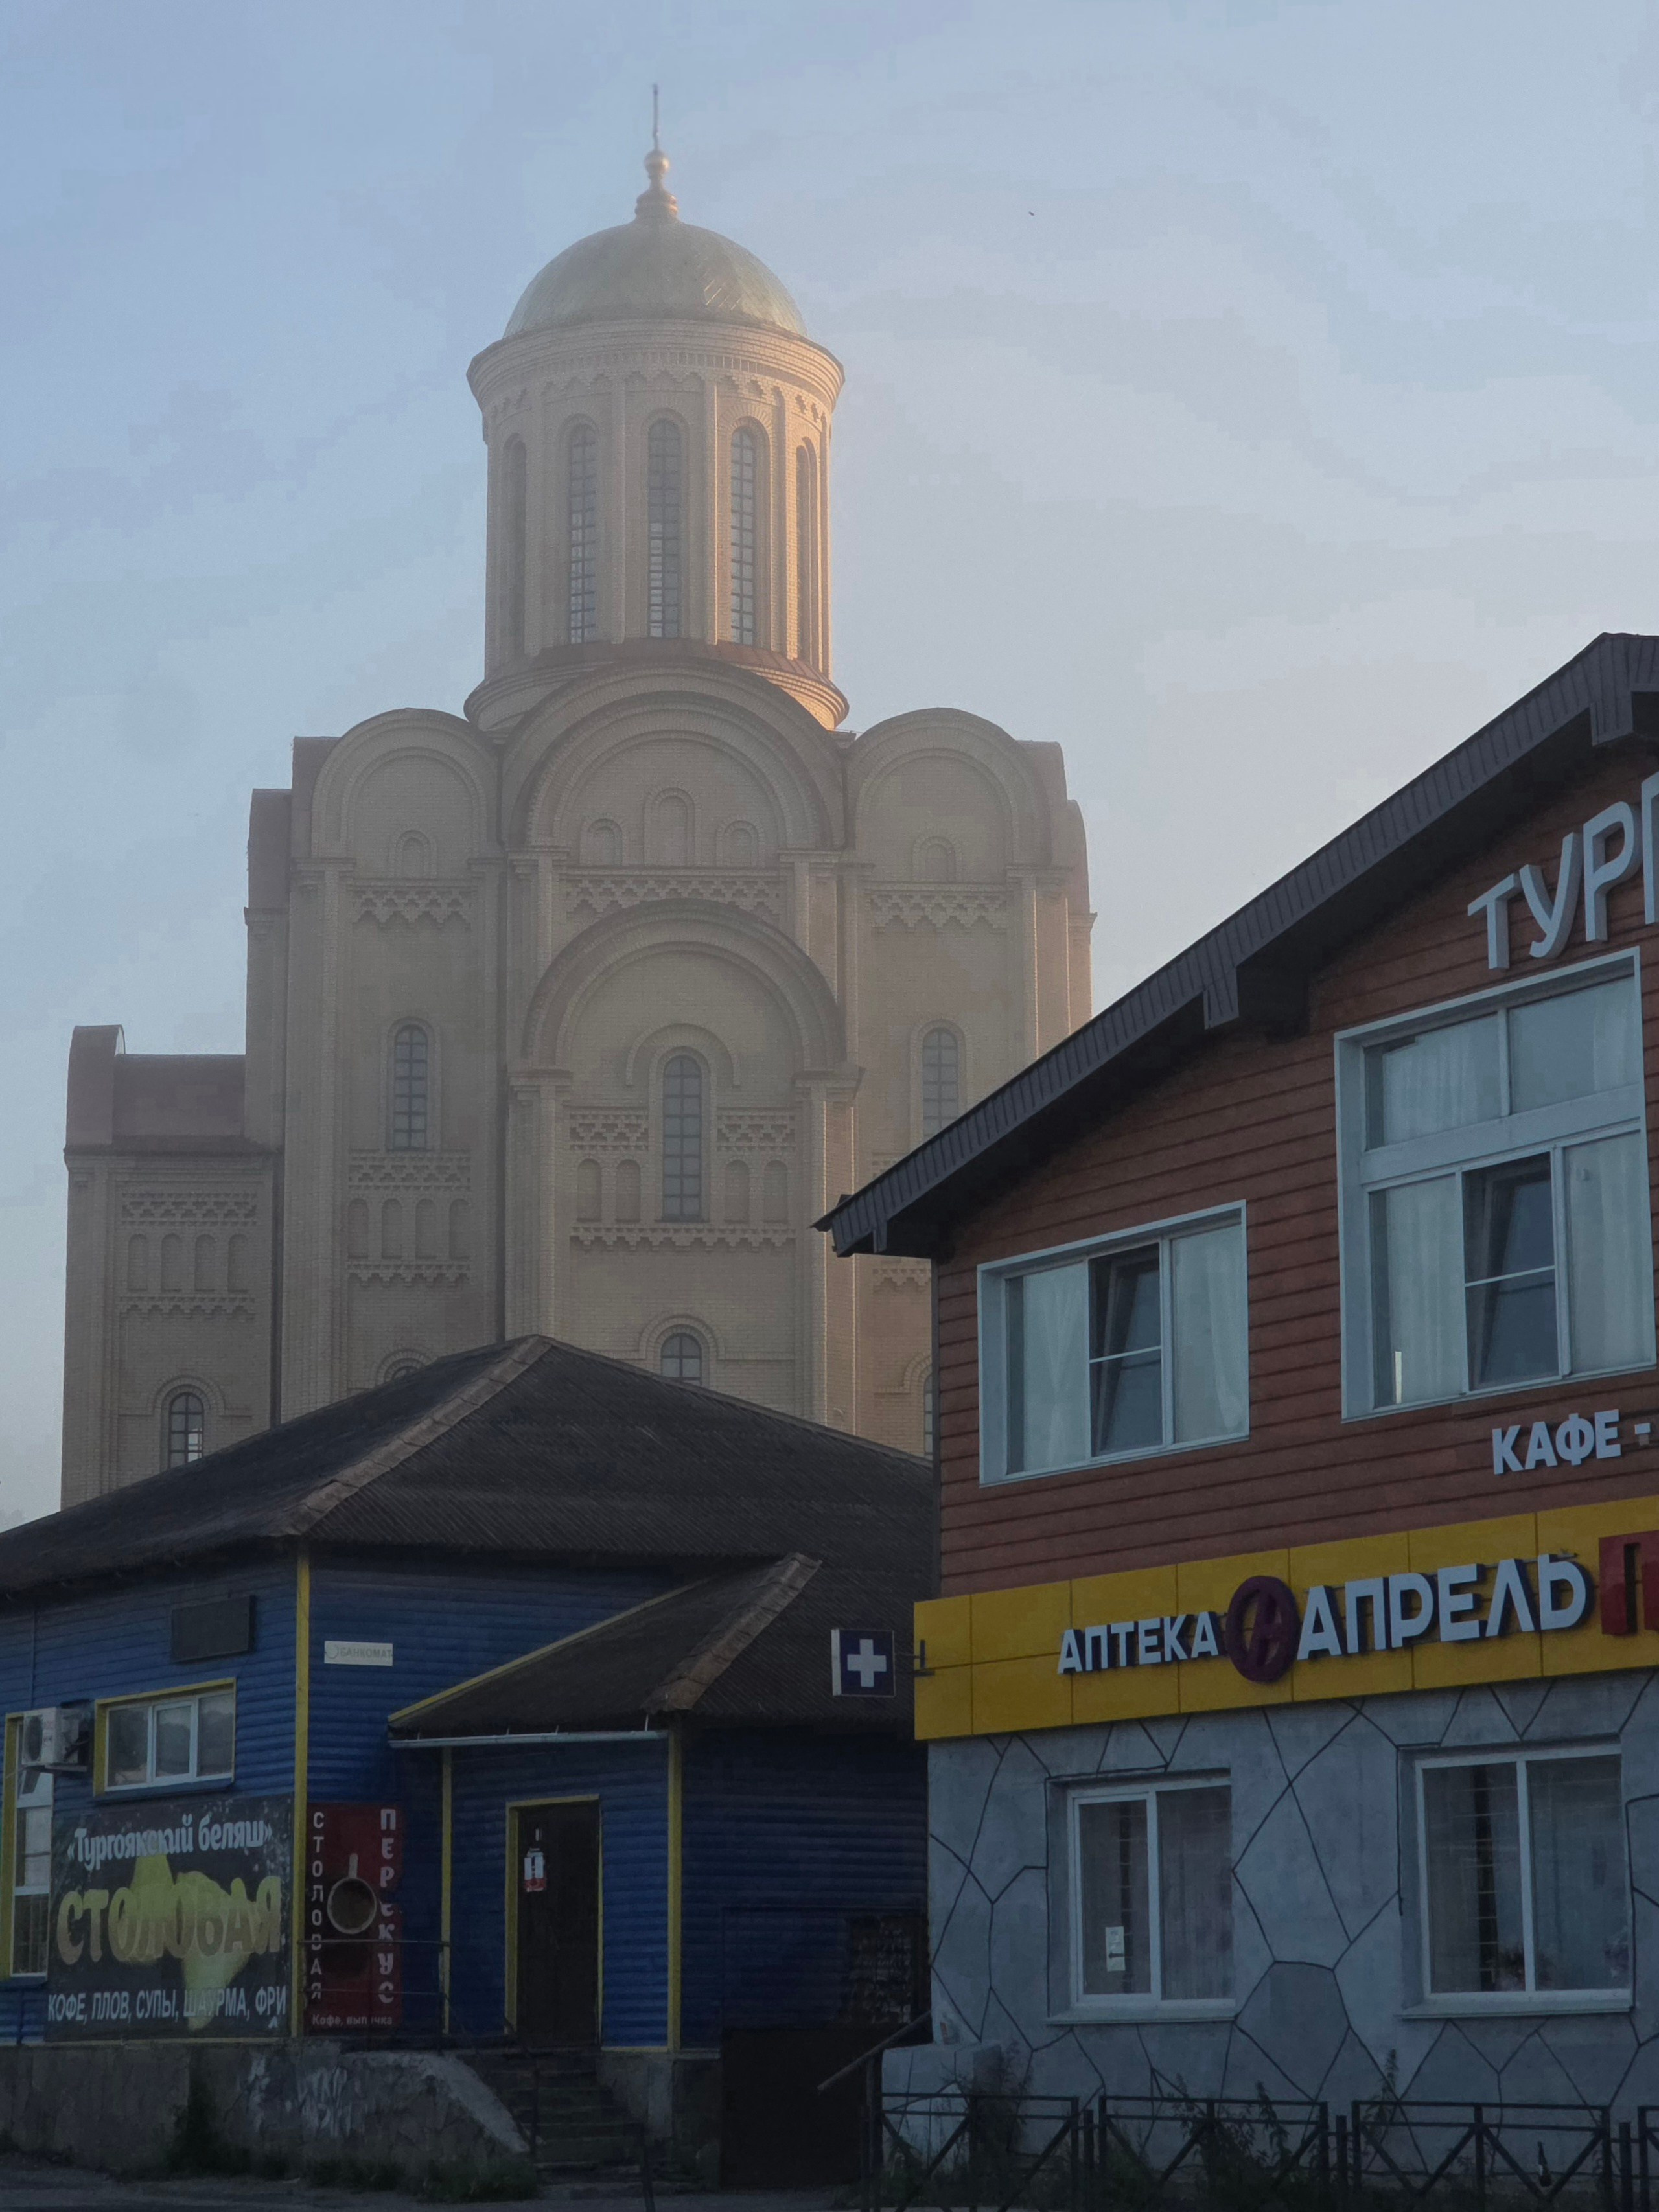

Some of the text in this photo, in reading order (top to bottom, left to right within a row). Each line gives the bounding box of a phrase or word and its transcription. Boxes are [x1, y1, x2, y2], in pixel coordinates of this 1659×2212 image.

[1492, 1409, 1621, 1475] КАФЕ
[1057, 1553, 1588, 1675] АПТЕКА АПРЕЛЬ
[135, 1988, 180, 2023] СУПЫ,
[255, 1985, 287, 2016] ФРИ
[346, 2015, 393, 2025] выпчка
